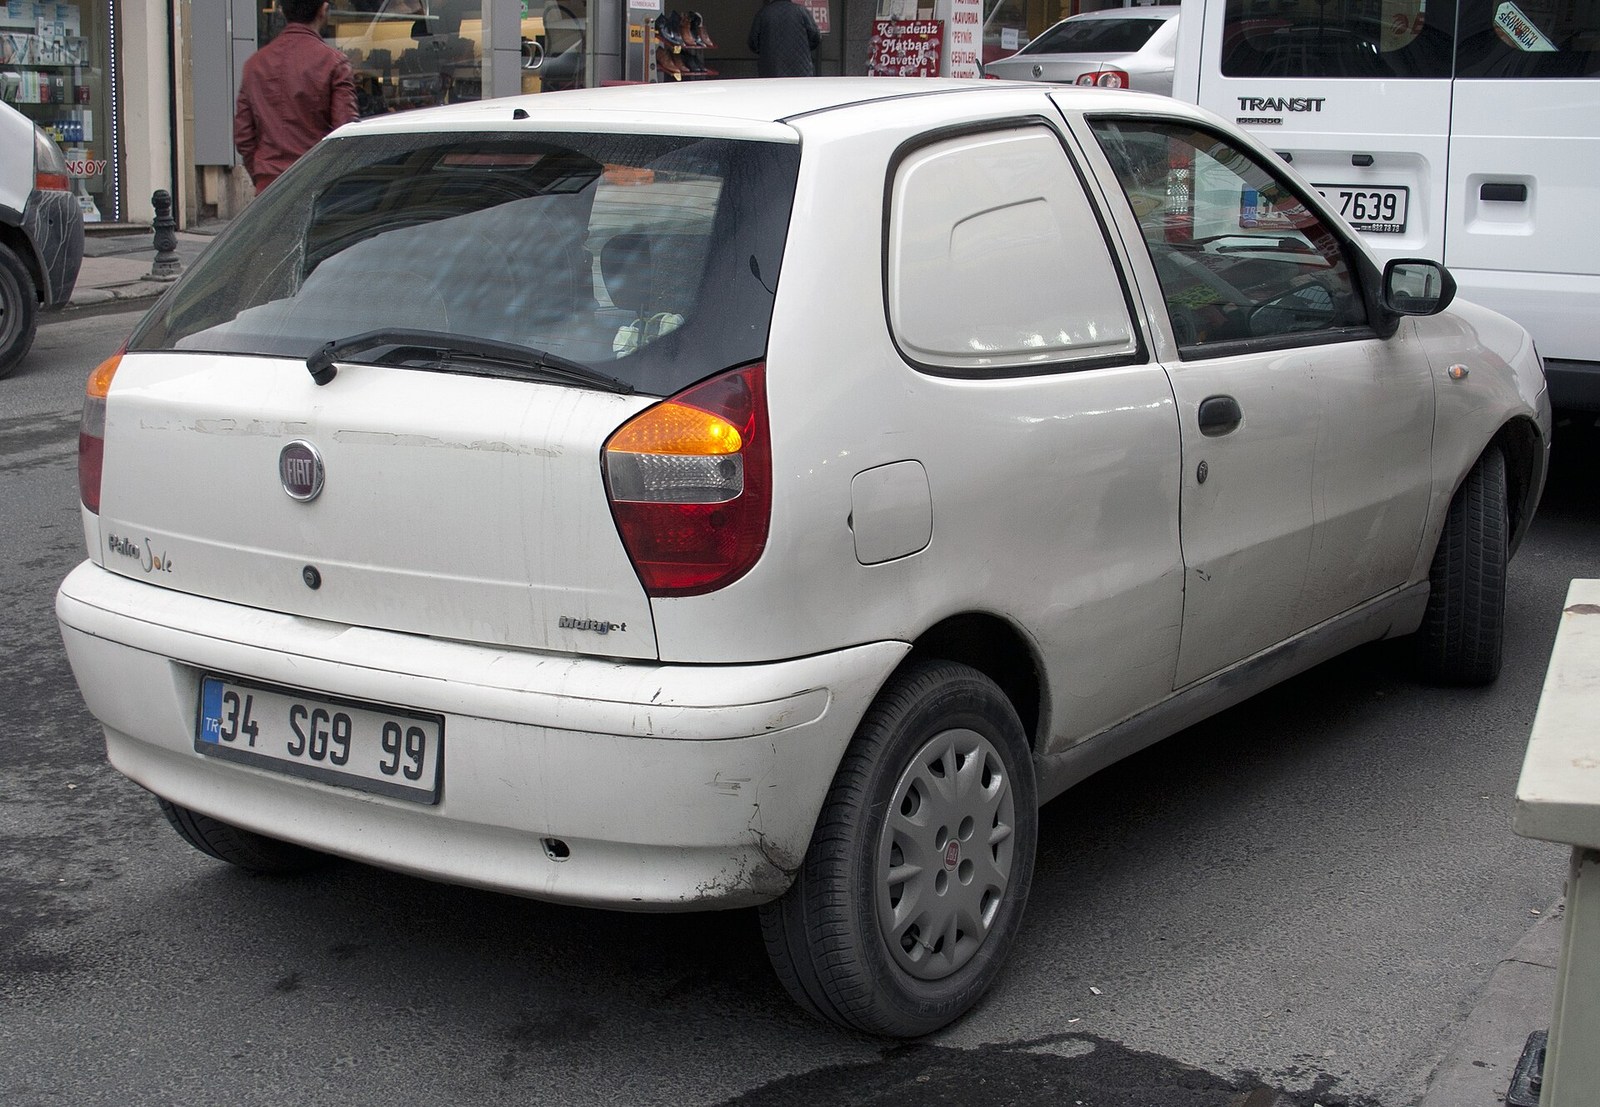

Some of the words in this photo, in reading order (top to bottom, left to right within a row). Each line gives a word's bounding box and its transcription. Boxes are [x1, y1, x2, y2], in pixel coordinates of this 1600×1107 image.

[1498, 12, 1535, 49] SEVIYRUM
[881, 39, 930, 53] Matbaa
[880, 54, 928, 68] Davetiye
[1237, 97, 1326, 112] TRANSIT
[1339, 191, 1397, 221] 7639
[287, 458, 312, 486] FIAT
[140, 537, 172, 573] Sole
[205, 716, 219, 734] TR
[220, 691, 259, 747] 34
[287, 704, 352, 766] SG9
[379, 721, 426, 781] 99
